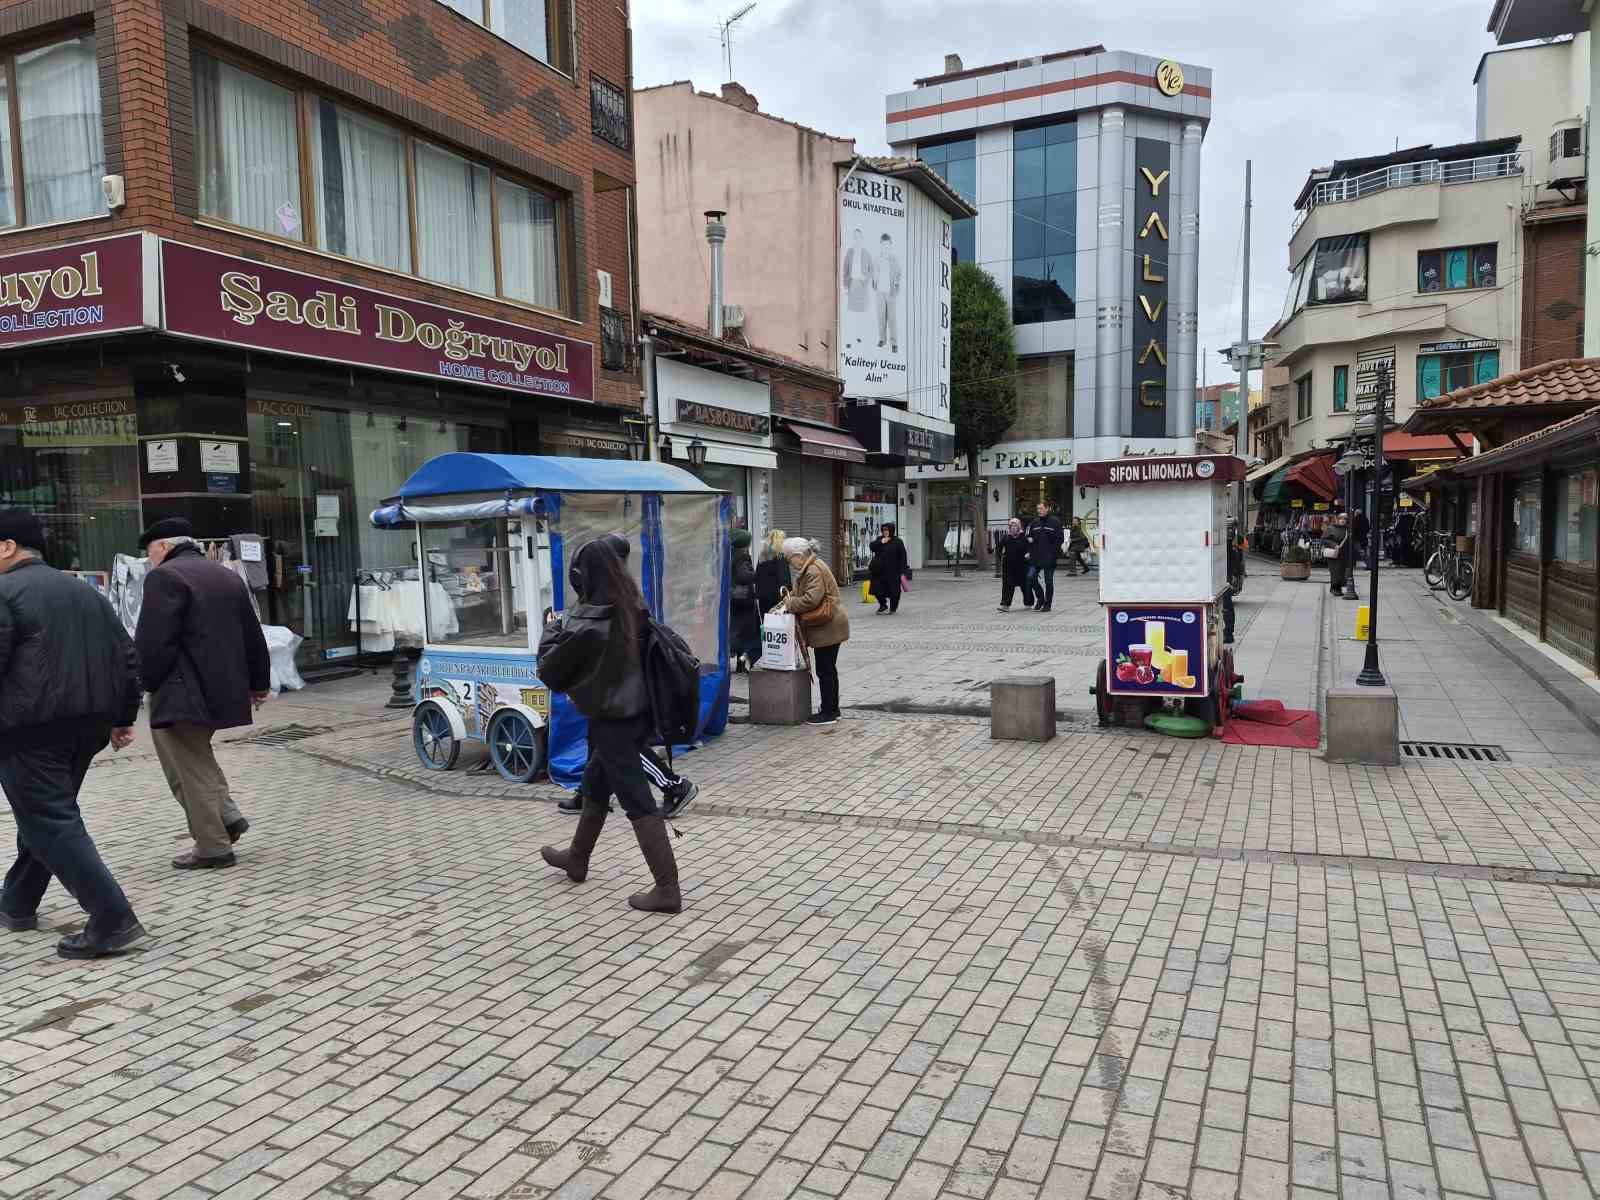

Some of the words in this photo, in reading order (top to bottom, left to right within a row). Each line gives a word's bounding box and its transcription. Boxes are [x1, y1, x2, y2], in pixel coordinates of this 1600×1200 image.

[842, 198, 861, 210] OKUL
[220, 271, 361, 335] Şadi
[374, 303, 569, 374] Doğruyol
[439, 361, 485, 381] HOME
[488, 369, 569, 394] COLLECTION
[70, 400, 128, 417] COLLECTION
[995, 449, 1073, 469] PERDE
[463, 683, 472, 700] 2
